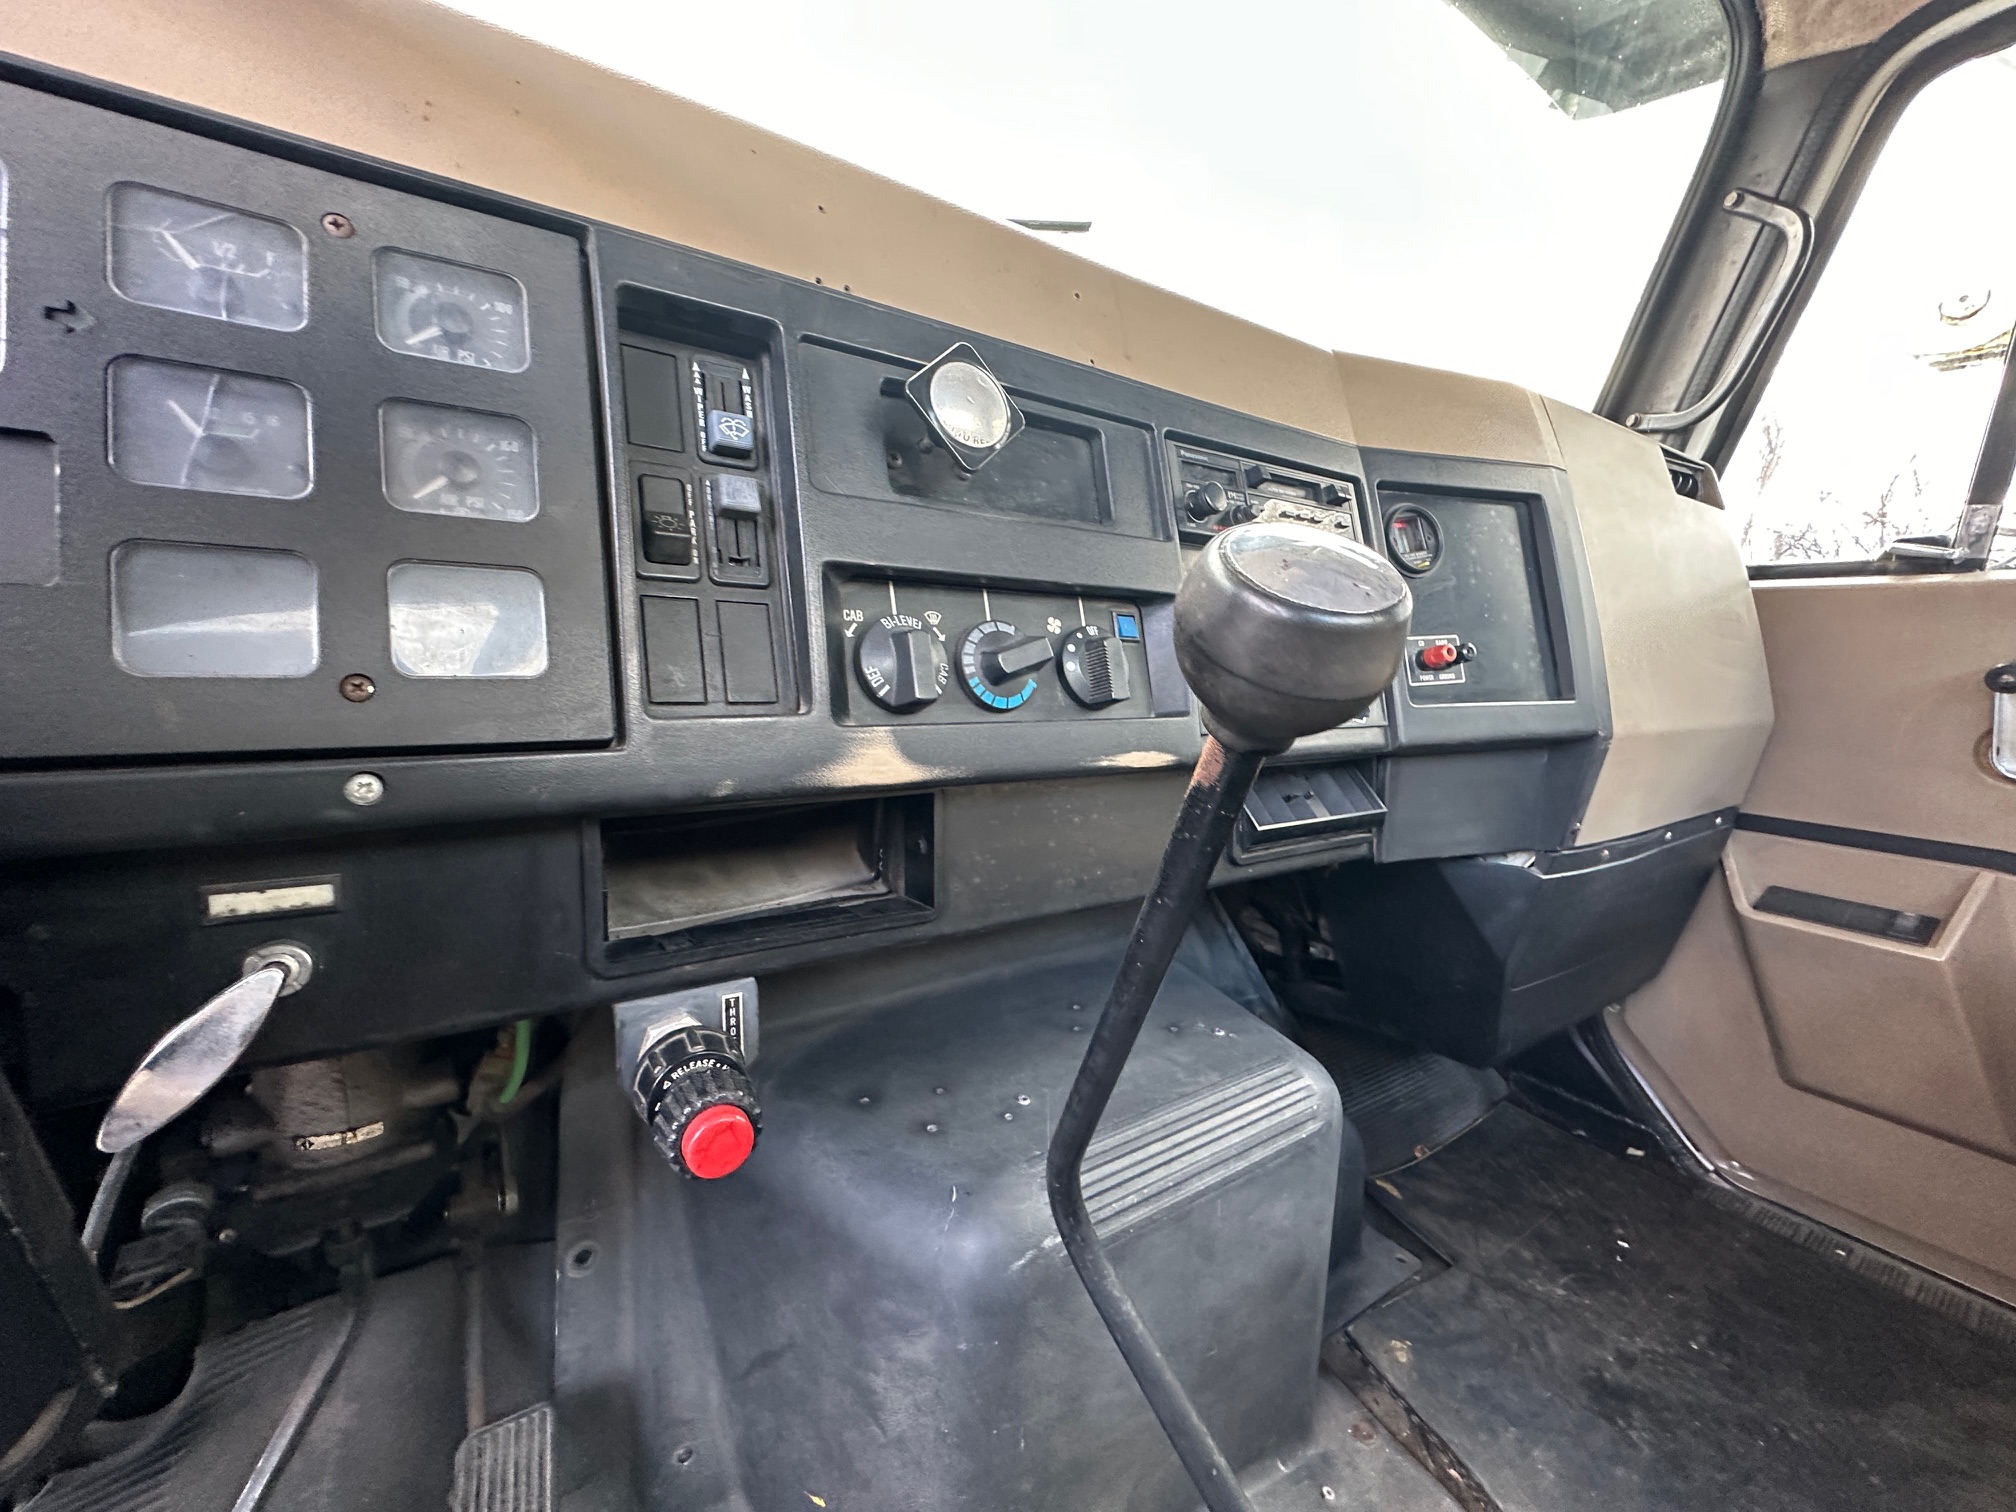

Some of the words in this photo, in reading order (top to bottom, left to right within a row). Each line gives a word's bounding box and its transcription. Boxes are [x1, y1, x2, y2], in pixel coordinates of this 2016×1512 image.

[693, 386, 706, 428] WIPER
[742, 385, 754, 419] WASH
[688, 510, 698, 546] PARK
[843, 609, 864, 622] CAB
[880, 614, 923, 630] BI-LEVEL
[1085, 625, 1099, 636] OFF
[864, 665, 885, 688] DEF
[937, 662, 950, 685] CAB
[670, 1058, 717, 1080] RELEASE
